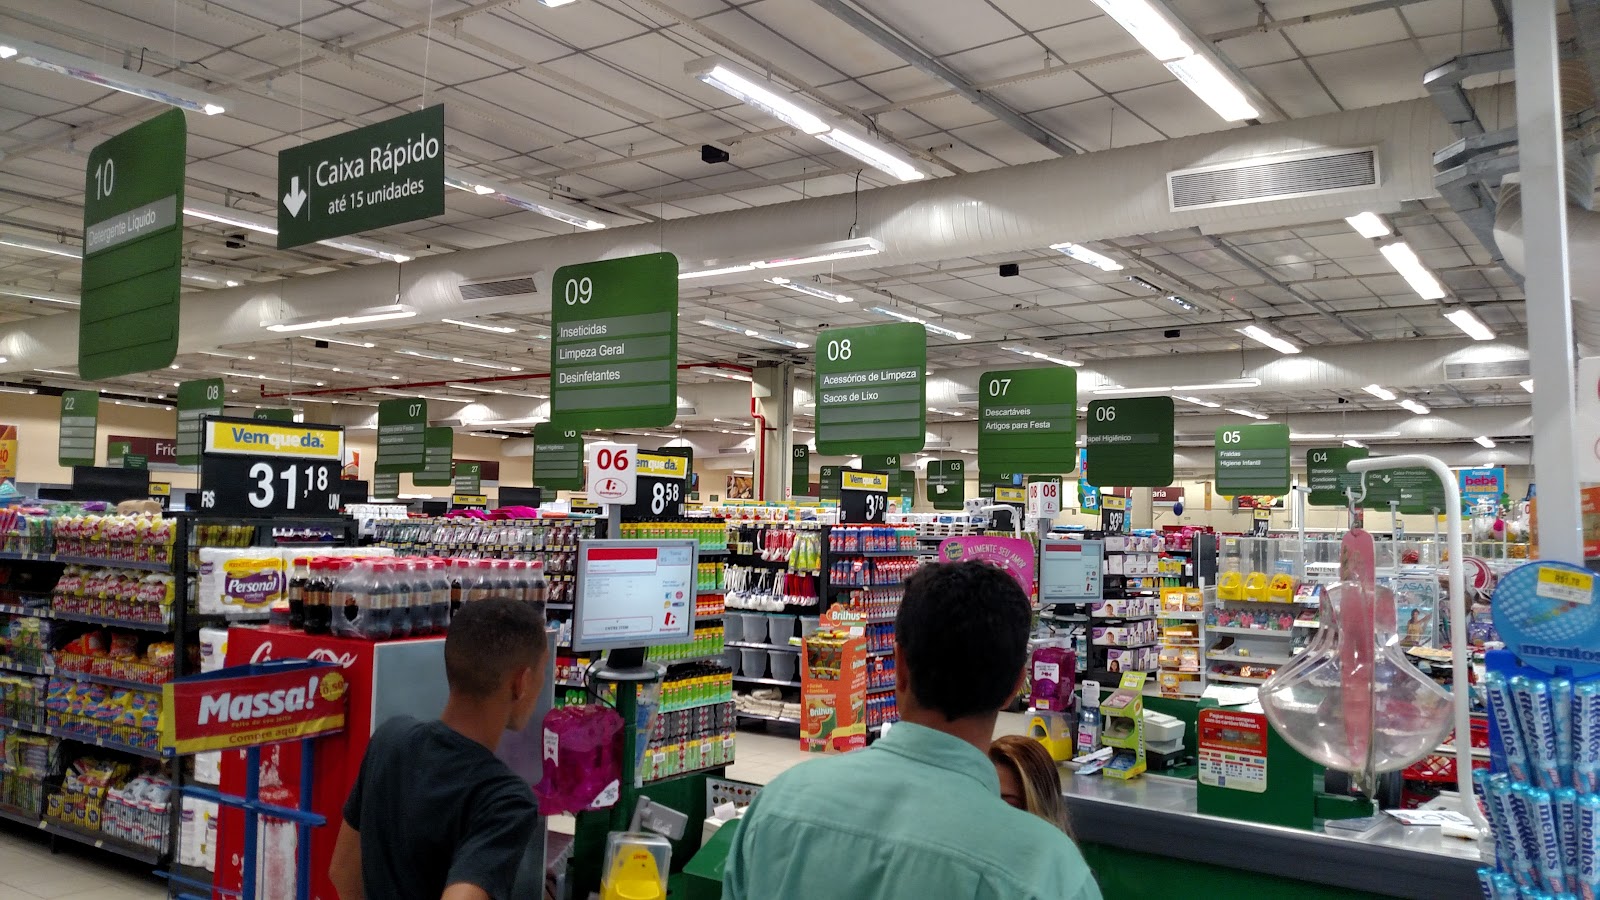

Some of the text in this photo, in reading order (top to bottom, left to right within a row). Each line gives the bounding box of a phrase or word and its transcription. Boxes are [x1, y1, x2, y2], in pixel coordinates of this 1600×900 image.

[315, 134, 440, 187] Caixa Rápido
[94, 158, 114, 200] 10
[327, 177, 425, 215] até 15 unidades
[565, 277, 593, 306] 09
[560, 323, 607, 338] Inseticidas
[559, 343, 625, 361] Limpeza Geral
[827, 339, 852, 361] 08
[559, 370, 621, 384] Desinfetantes
[823, 370, 917, 385] Acessórios de Limpeza
[206, 385, 219, 400] 08
[989, 378, 1011, 397] 07
[65, 397, 75, 410] 22
[823, 391, 878, 403] Sacos de Lixo
[409, 403, 422, 417] 07
[985, 407, 1031, 416] Descartáveis
[1096, 406, 1116, 421] 06
[985, 420, 1050, 431] Artigos para Festa
[1102, 433, 1132, 442] Higiênico
[1223, 431, 1241, 444] 05
[597, 448, 629, 471] 06
[794, 448, 805, 457] 05
[1313, 452, 1328, 463] 04
[886, 456, 896, 465] 04
[950, 462, 961, 471] 03
[823, 468, 832, 476] 28
[1465, 475, 1497, 485] bebê
[1030, 485, 1037, 498] 08
[1043, 484, 1057, 498] 08
[201, 491, 215, 508] R$
[328, 493, 340, 510] UN
[968, 544, 997, 556] ALIMENTE
[998, 546, 1010, 558] SEU
[1010, 553, 1026, 569] AMOR
[228, 577, 277, 594] Personal
[832, 610, 860, 621] Brilhus
[198, 676, 319, 726] Massa!
[1491, 690, 1518, 757] mentos
[1538, 693, 1557, 760] mentos
[229, 725, 298, 744] Compre aqui
[1538, 804, 1558, 870] mentos
[1562, 803, 1579, 867] mentos
[1581, 808, 1595, 876] mentos
